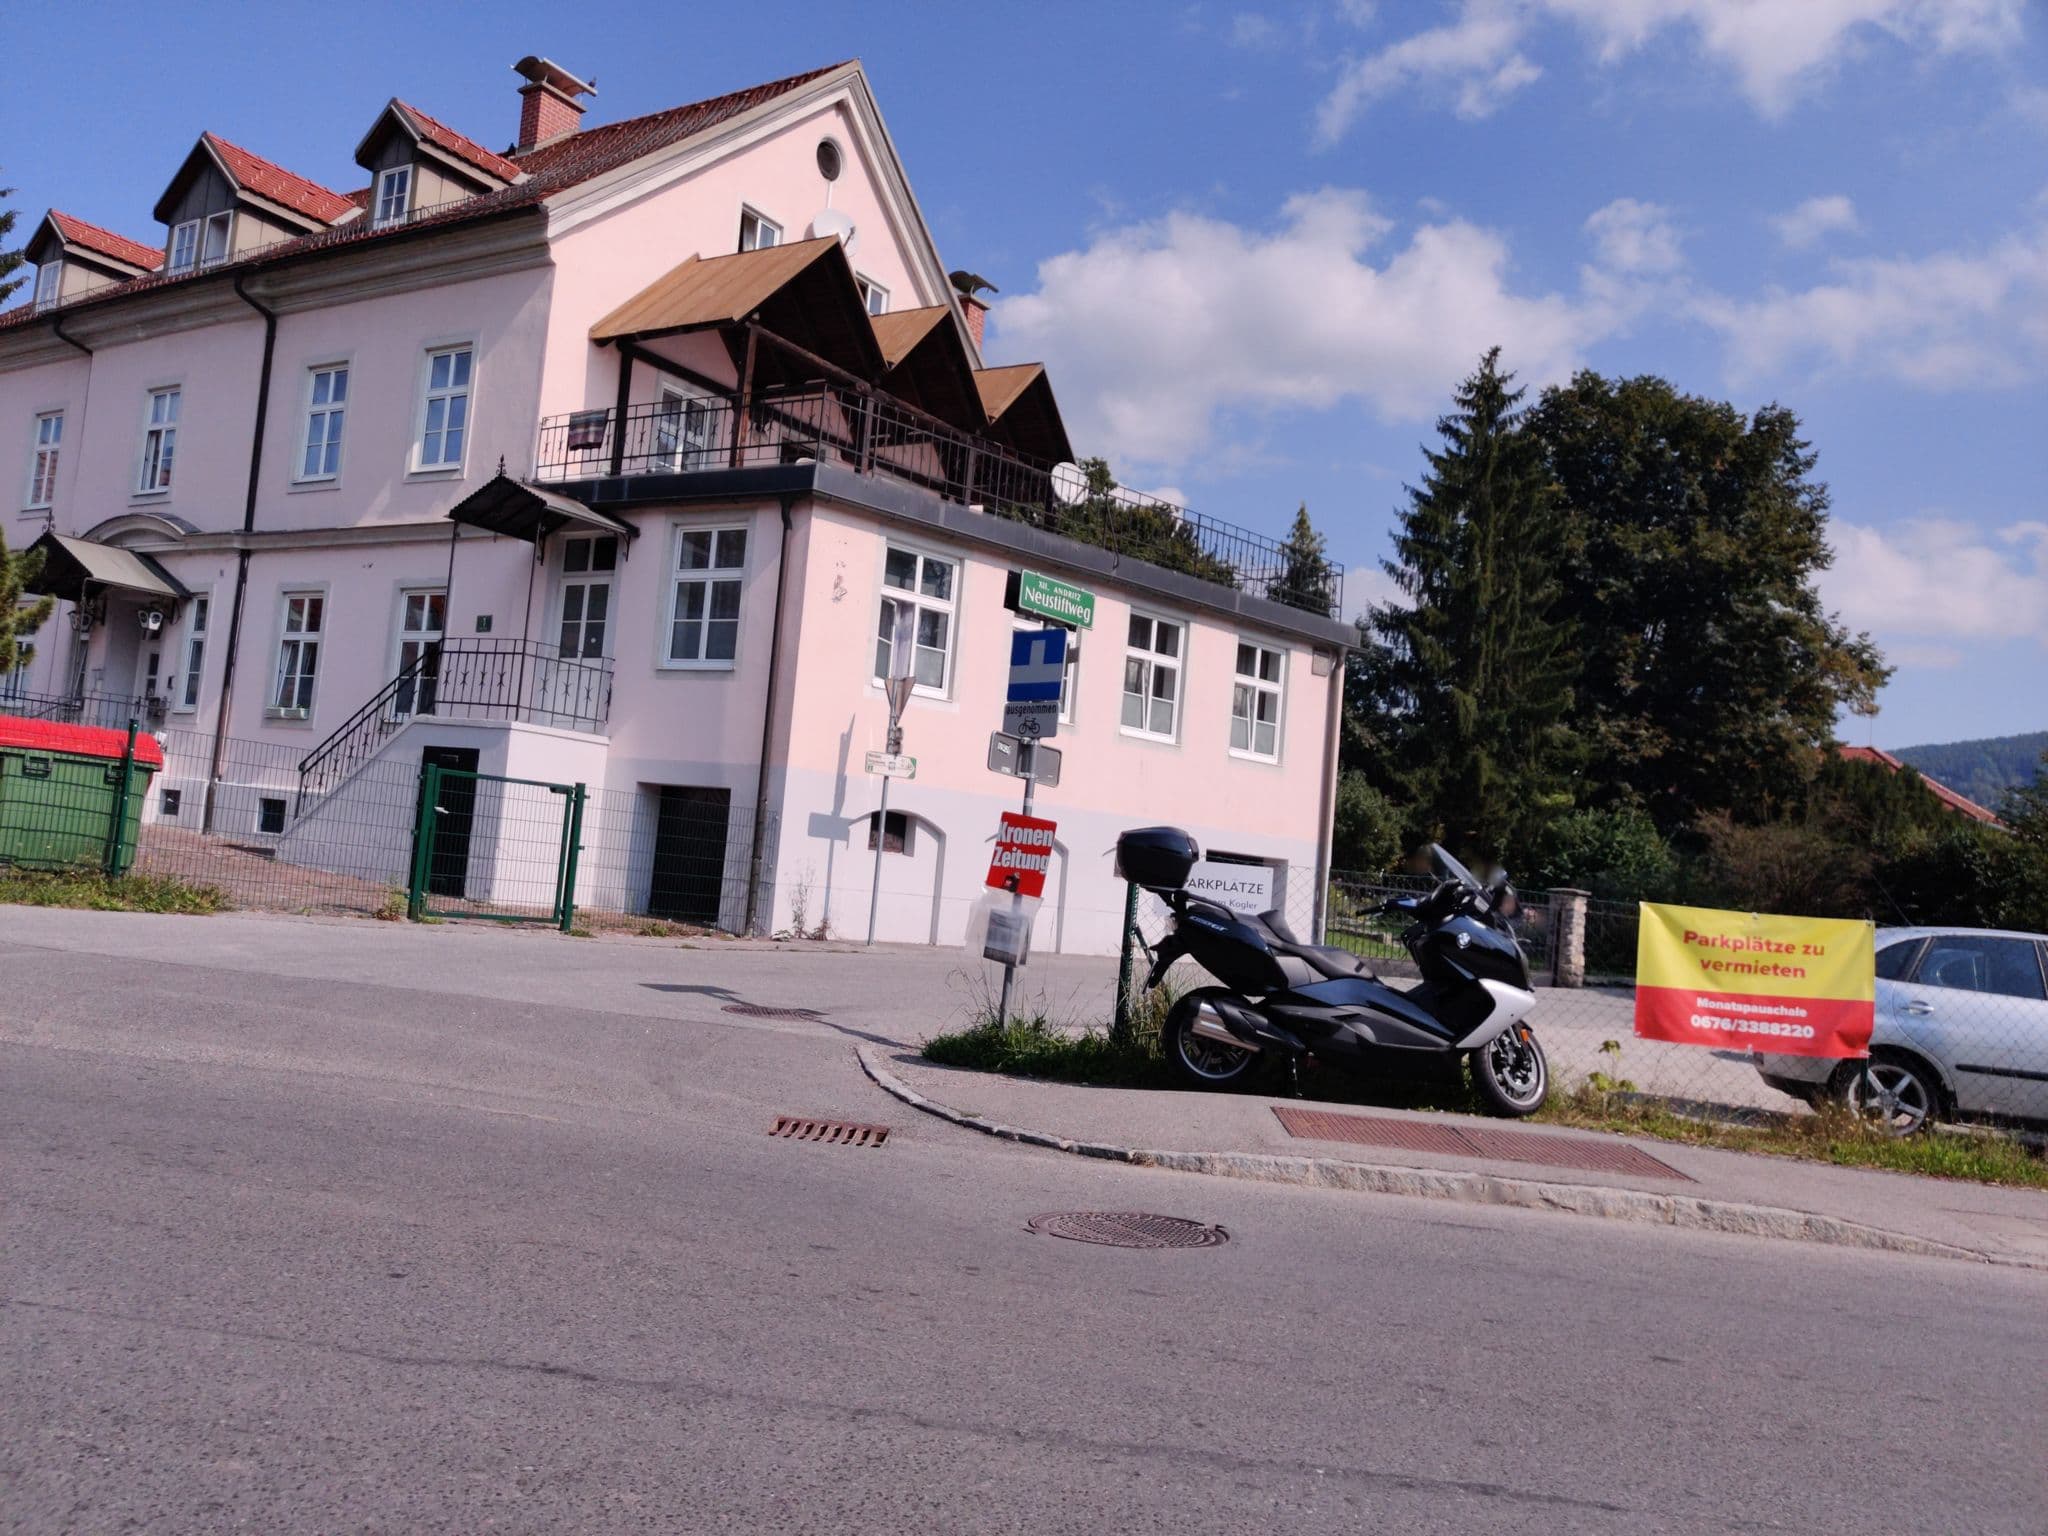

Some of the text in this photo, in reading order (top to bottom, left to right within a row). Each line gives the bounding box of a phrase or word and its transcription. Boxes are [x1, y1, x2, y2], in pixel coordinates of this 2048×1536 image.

[1024, 585, 1091, 624] Neustiftweg
[1053, 586, 1082, 602] ANDRITZ
[1006, 704, 1057, 717] ausgenommen
[997, 821, 1055, 847] Kronen
[993, 847, 1051, 874] Zeitung
[1229, 899, 1258, 910] Kogler
[1683, 929, 1825, 956] Parkplätze zu
[1700, 959, 1806, 978] vermieten
[1696, 996, 1808, 1018] Monatspauschale
